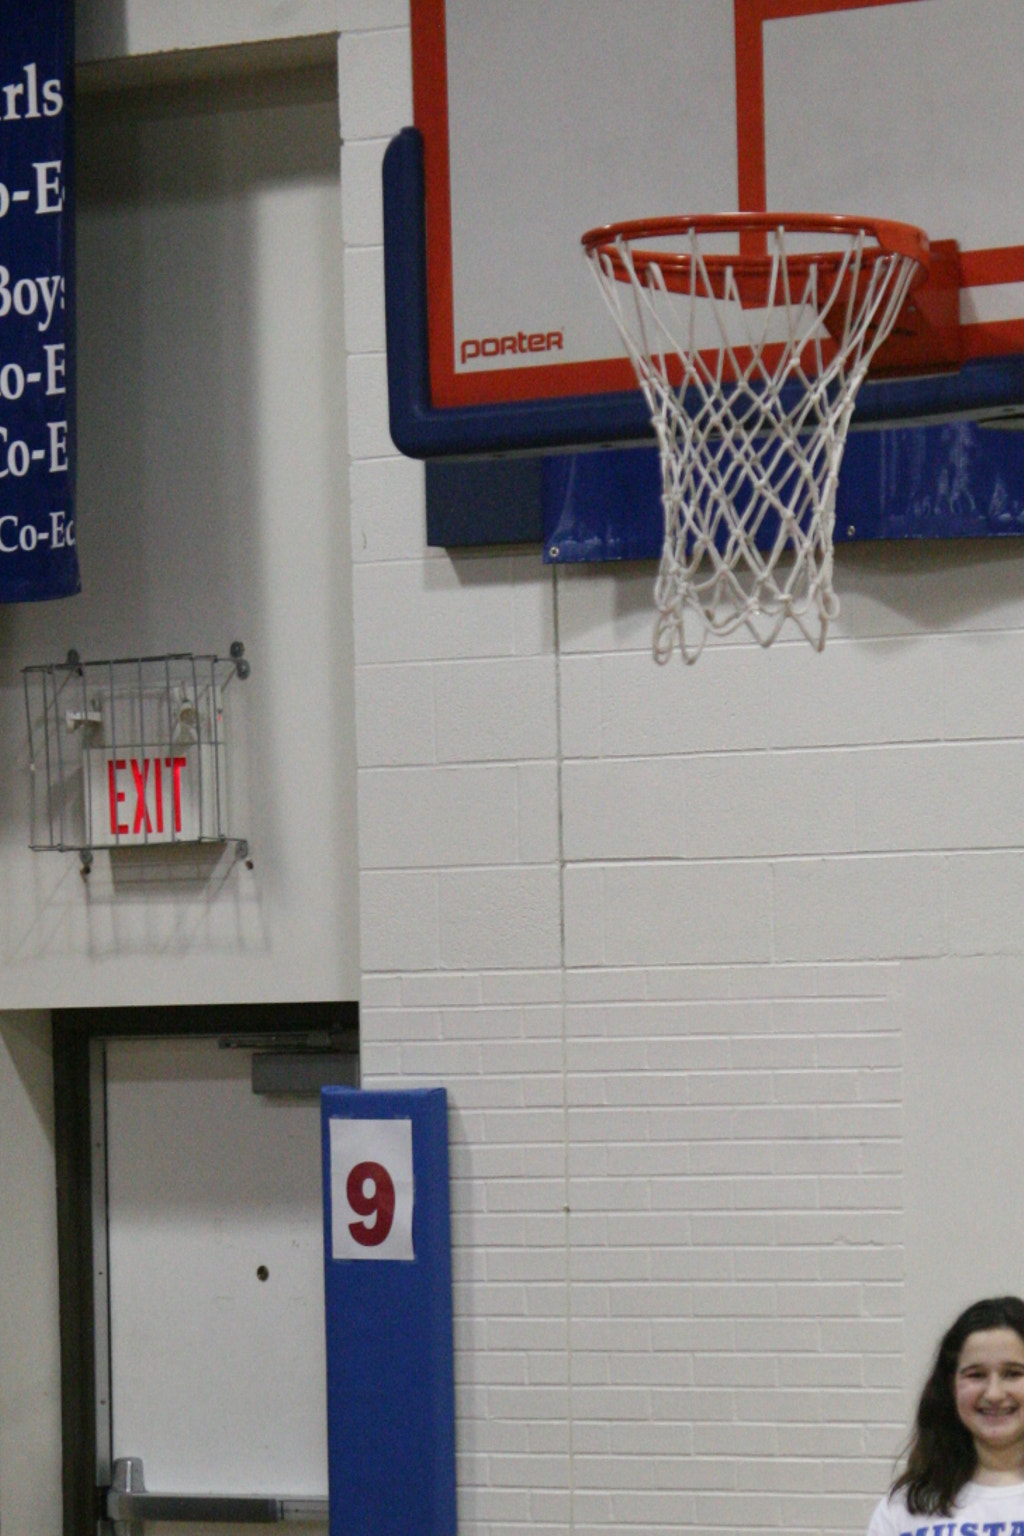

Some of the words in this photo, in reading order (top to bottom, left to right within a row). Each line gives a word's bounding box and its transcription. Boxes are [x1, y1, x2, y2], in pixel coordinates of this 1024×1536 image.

[0, 62, 64, 121] rls
[0, 343, 66, 400] o-E
[107, 757, 187, 835] EXIT
[346, 1160, 396, 1247] 9
